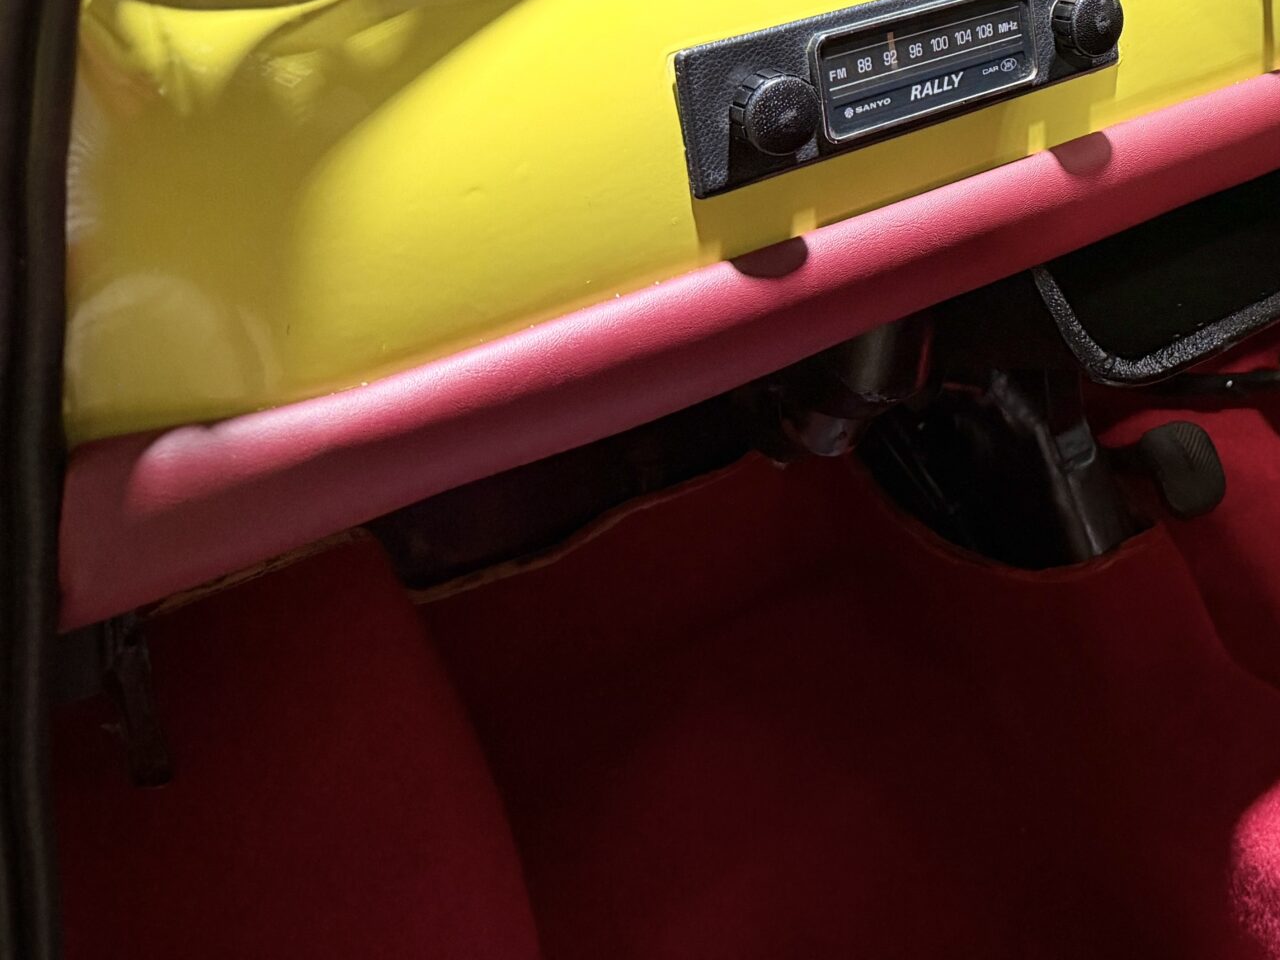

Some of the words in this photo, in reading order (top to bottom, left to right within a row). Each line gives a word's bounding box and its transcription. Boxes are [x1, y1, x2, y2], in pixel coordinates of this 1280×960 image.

[829, 67, 847, 82] FM
[857, 56, 872, 73] 88
[883, 49, 898, 66] 92
[908, 42, 923, 59] 96
[930, 35, 949, 52] 100
[954, 28, 972, 46] 104
[976, 23, 994, 40] 108
[998, 20, 1018, 34] MHz
[982, 65, 999, 75] CAR
[910, 71, 964, 102] RALLY
[855, 97, 892, 114] SANYO
